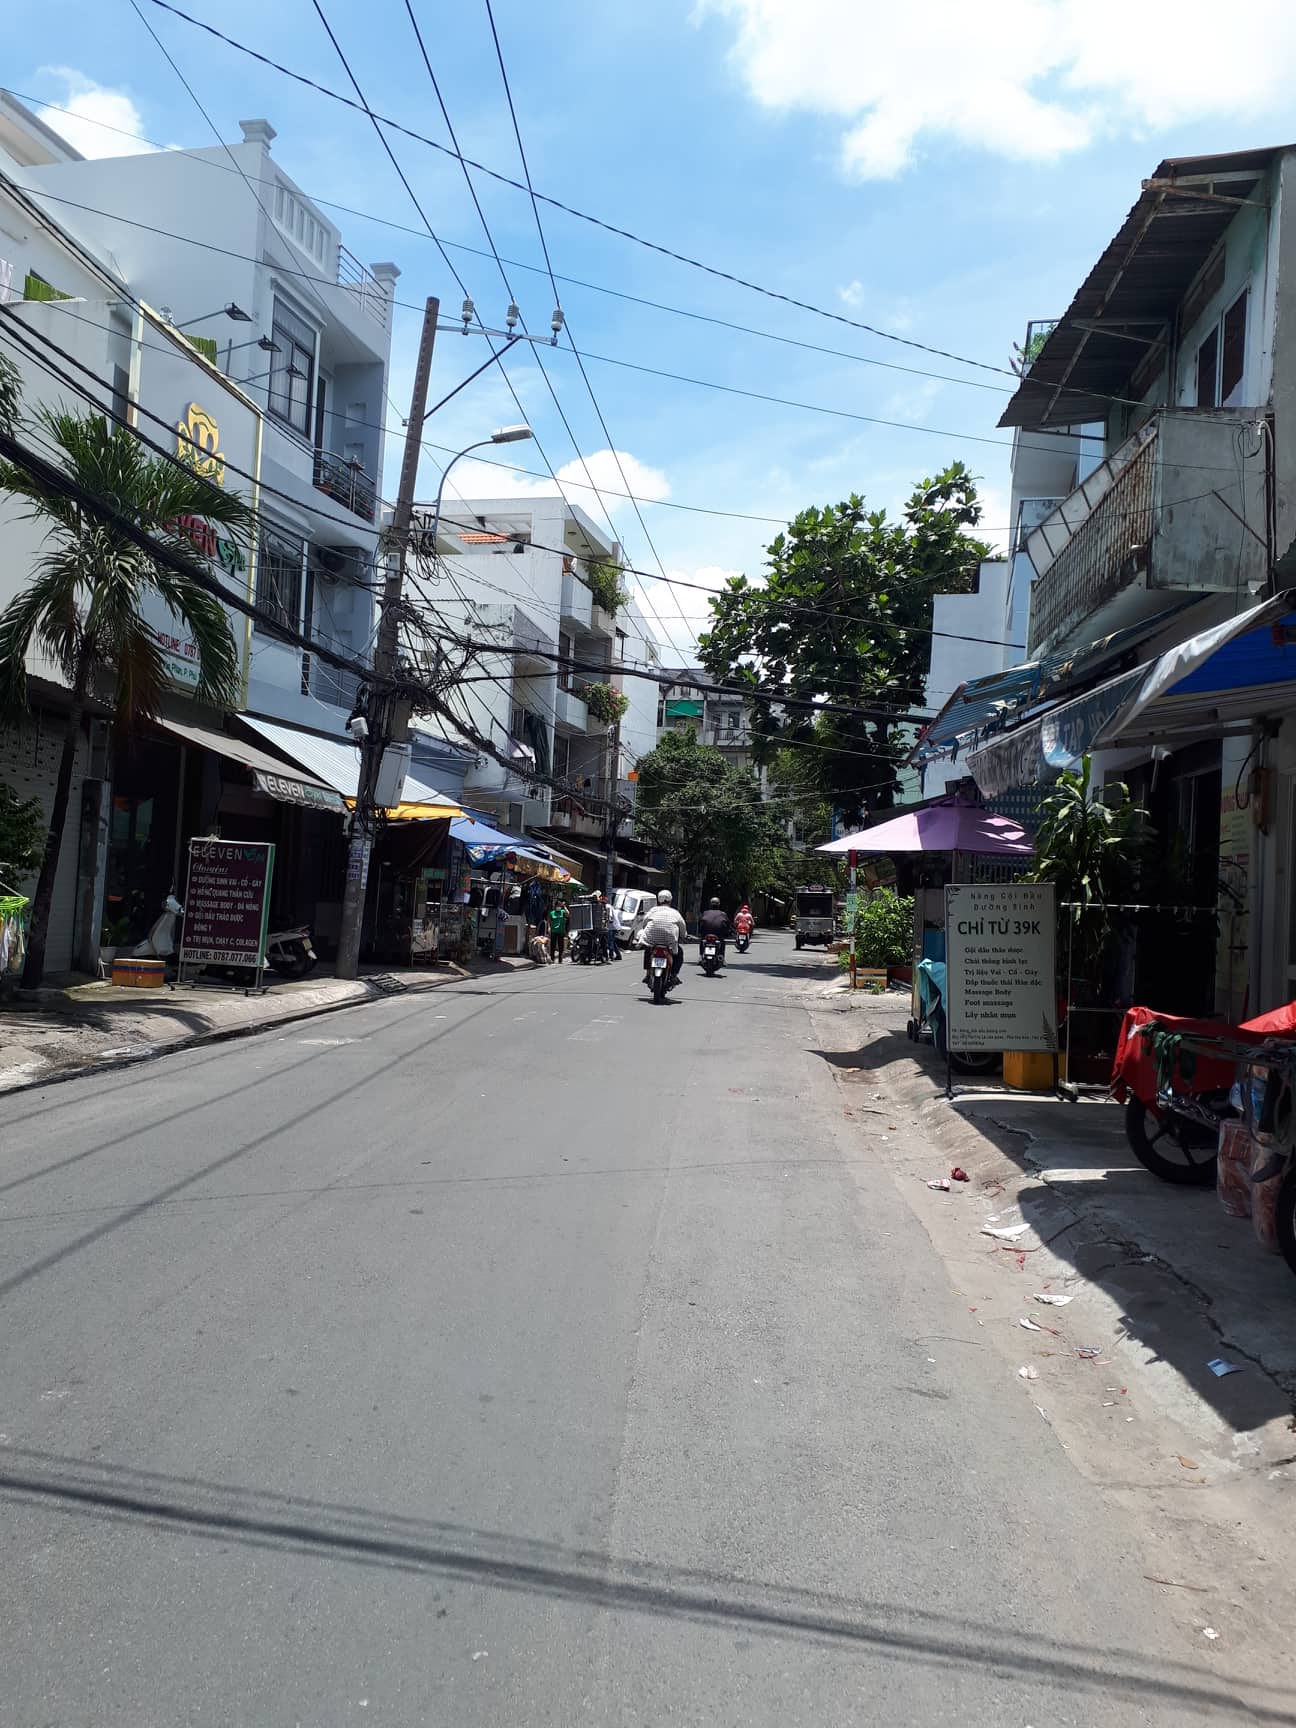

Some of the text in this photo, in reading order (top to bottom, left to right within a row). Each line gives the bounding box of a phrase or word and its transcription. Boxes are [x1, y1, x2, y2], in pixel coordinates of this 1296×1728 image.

[266, 775, 305, 799] ELEVEN
[193, 845, 242, 860] ELEVEN
[196, 900, 218, 909] MASSAGE
[957, 917, 1041, 935] CHỈ TỪ 39K
[183, 950, 212, 960] HOTLINE:
[994, 988, 1012, 996] Body
[982, 1000, 1013, 1008] massage
